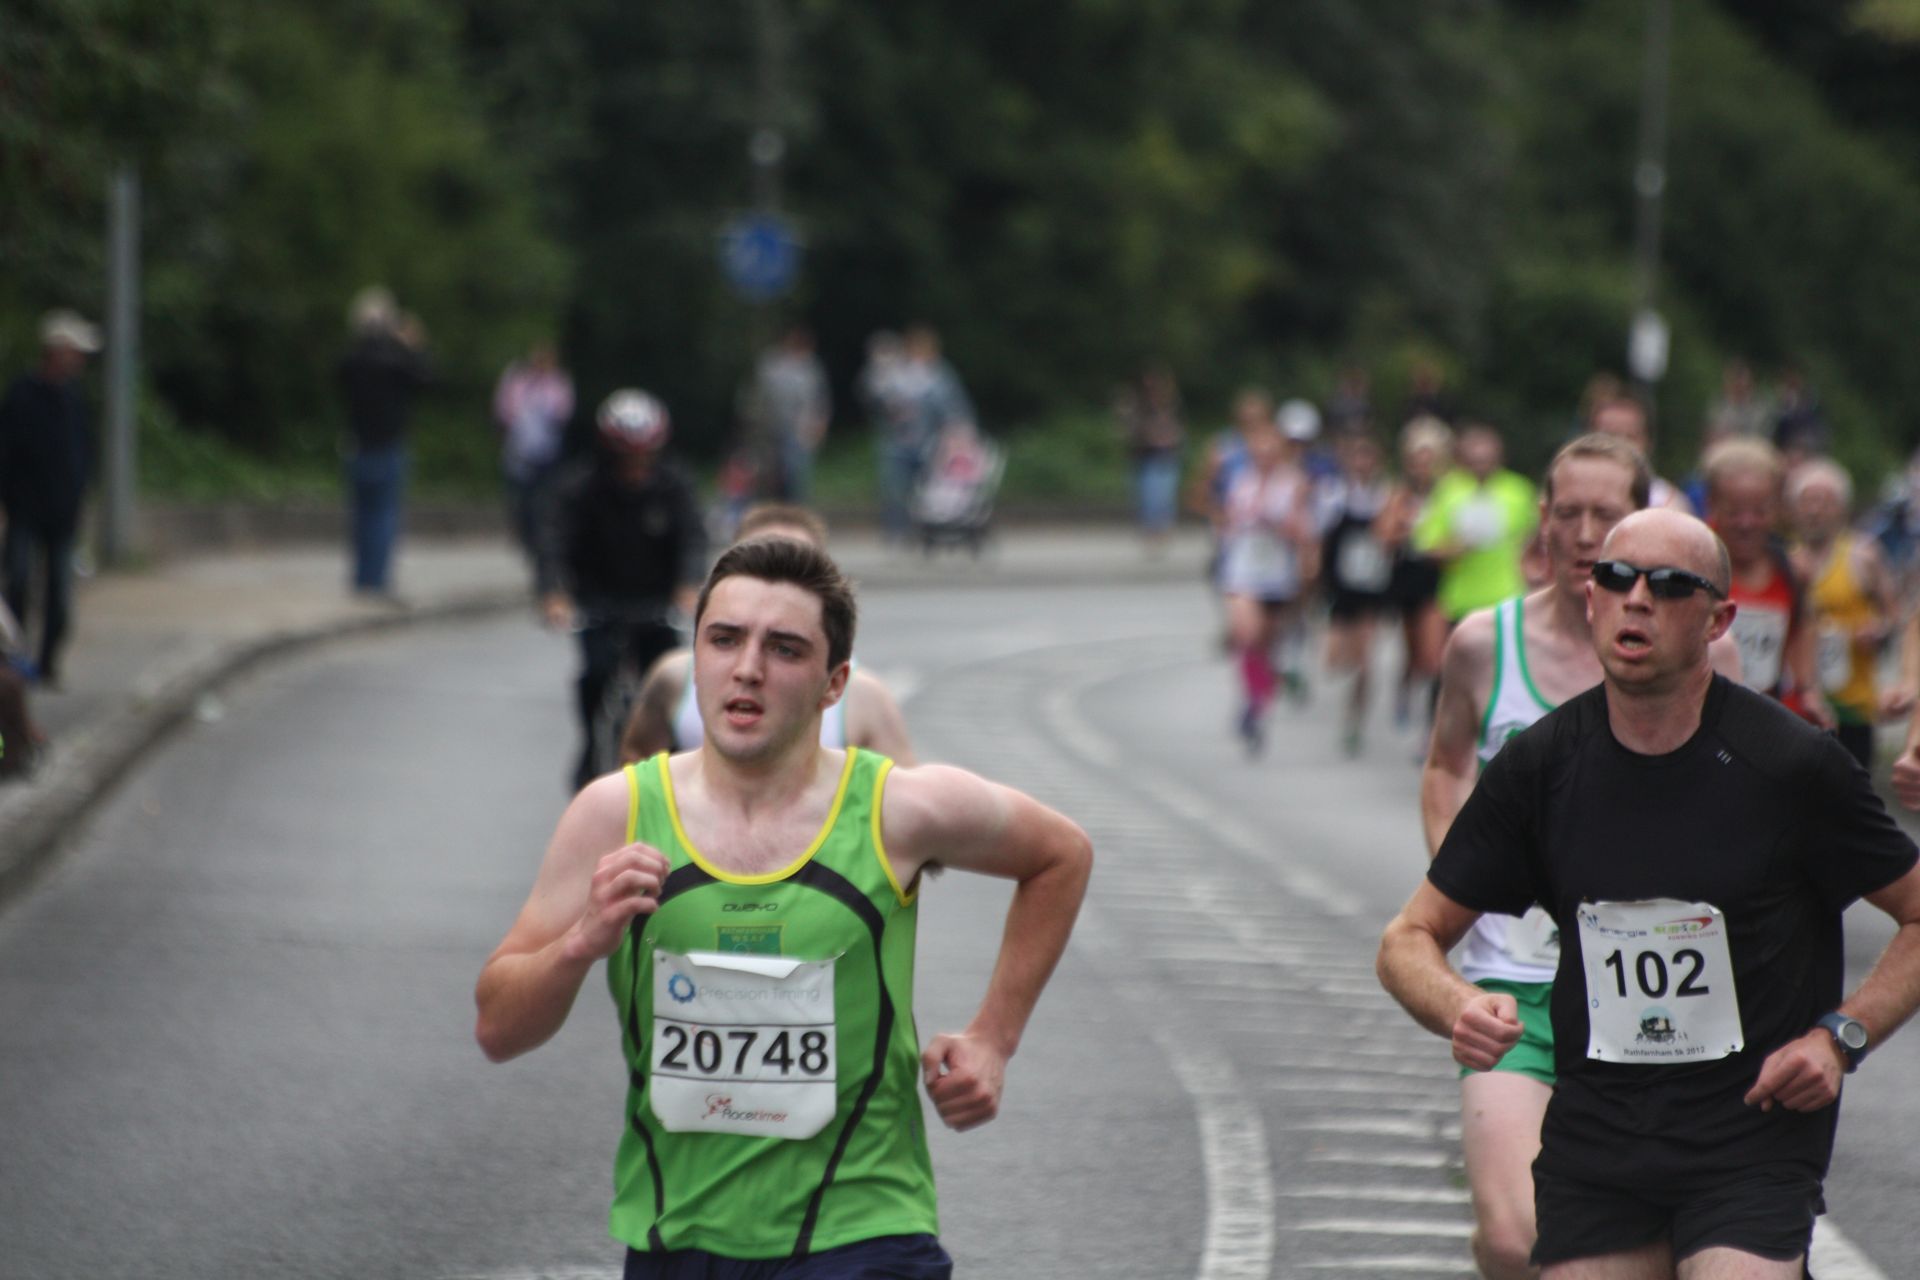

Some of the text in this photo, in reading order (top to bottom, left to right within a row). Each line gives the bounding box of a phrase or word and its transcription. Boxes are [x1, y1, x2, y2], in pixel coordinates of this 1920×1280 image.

[699, 986, 820, 1003] Precision Timing
[1605, 949, 1710, 999] 102
[660, 1025, 828, 1076] 20748
